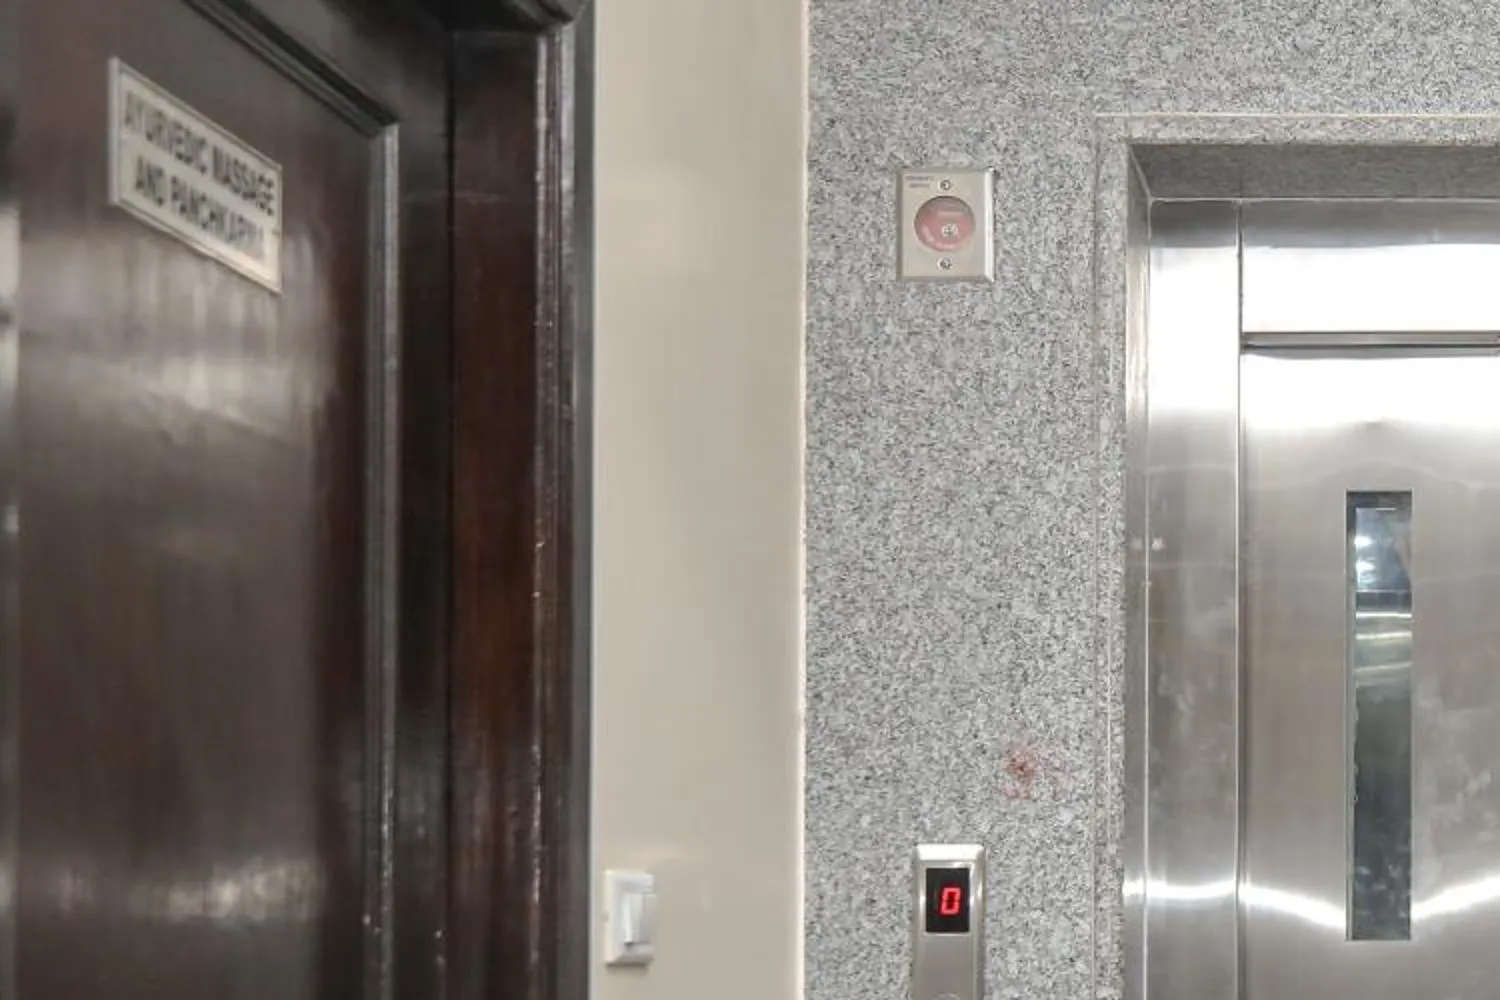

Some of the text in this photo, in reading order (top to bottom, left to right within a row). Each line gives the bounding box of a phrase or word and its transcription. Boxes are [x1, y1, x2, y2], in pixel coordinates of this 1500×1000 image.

[123, 90, 275, 217] AYURVEDIC MASSAGE
[135, 154, 166, 206] AND
[940, 887, 962, 915] 0
